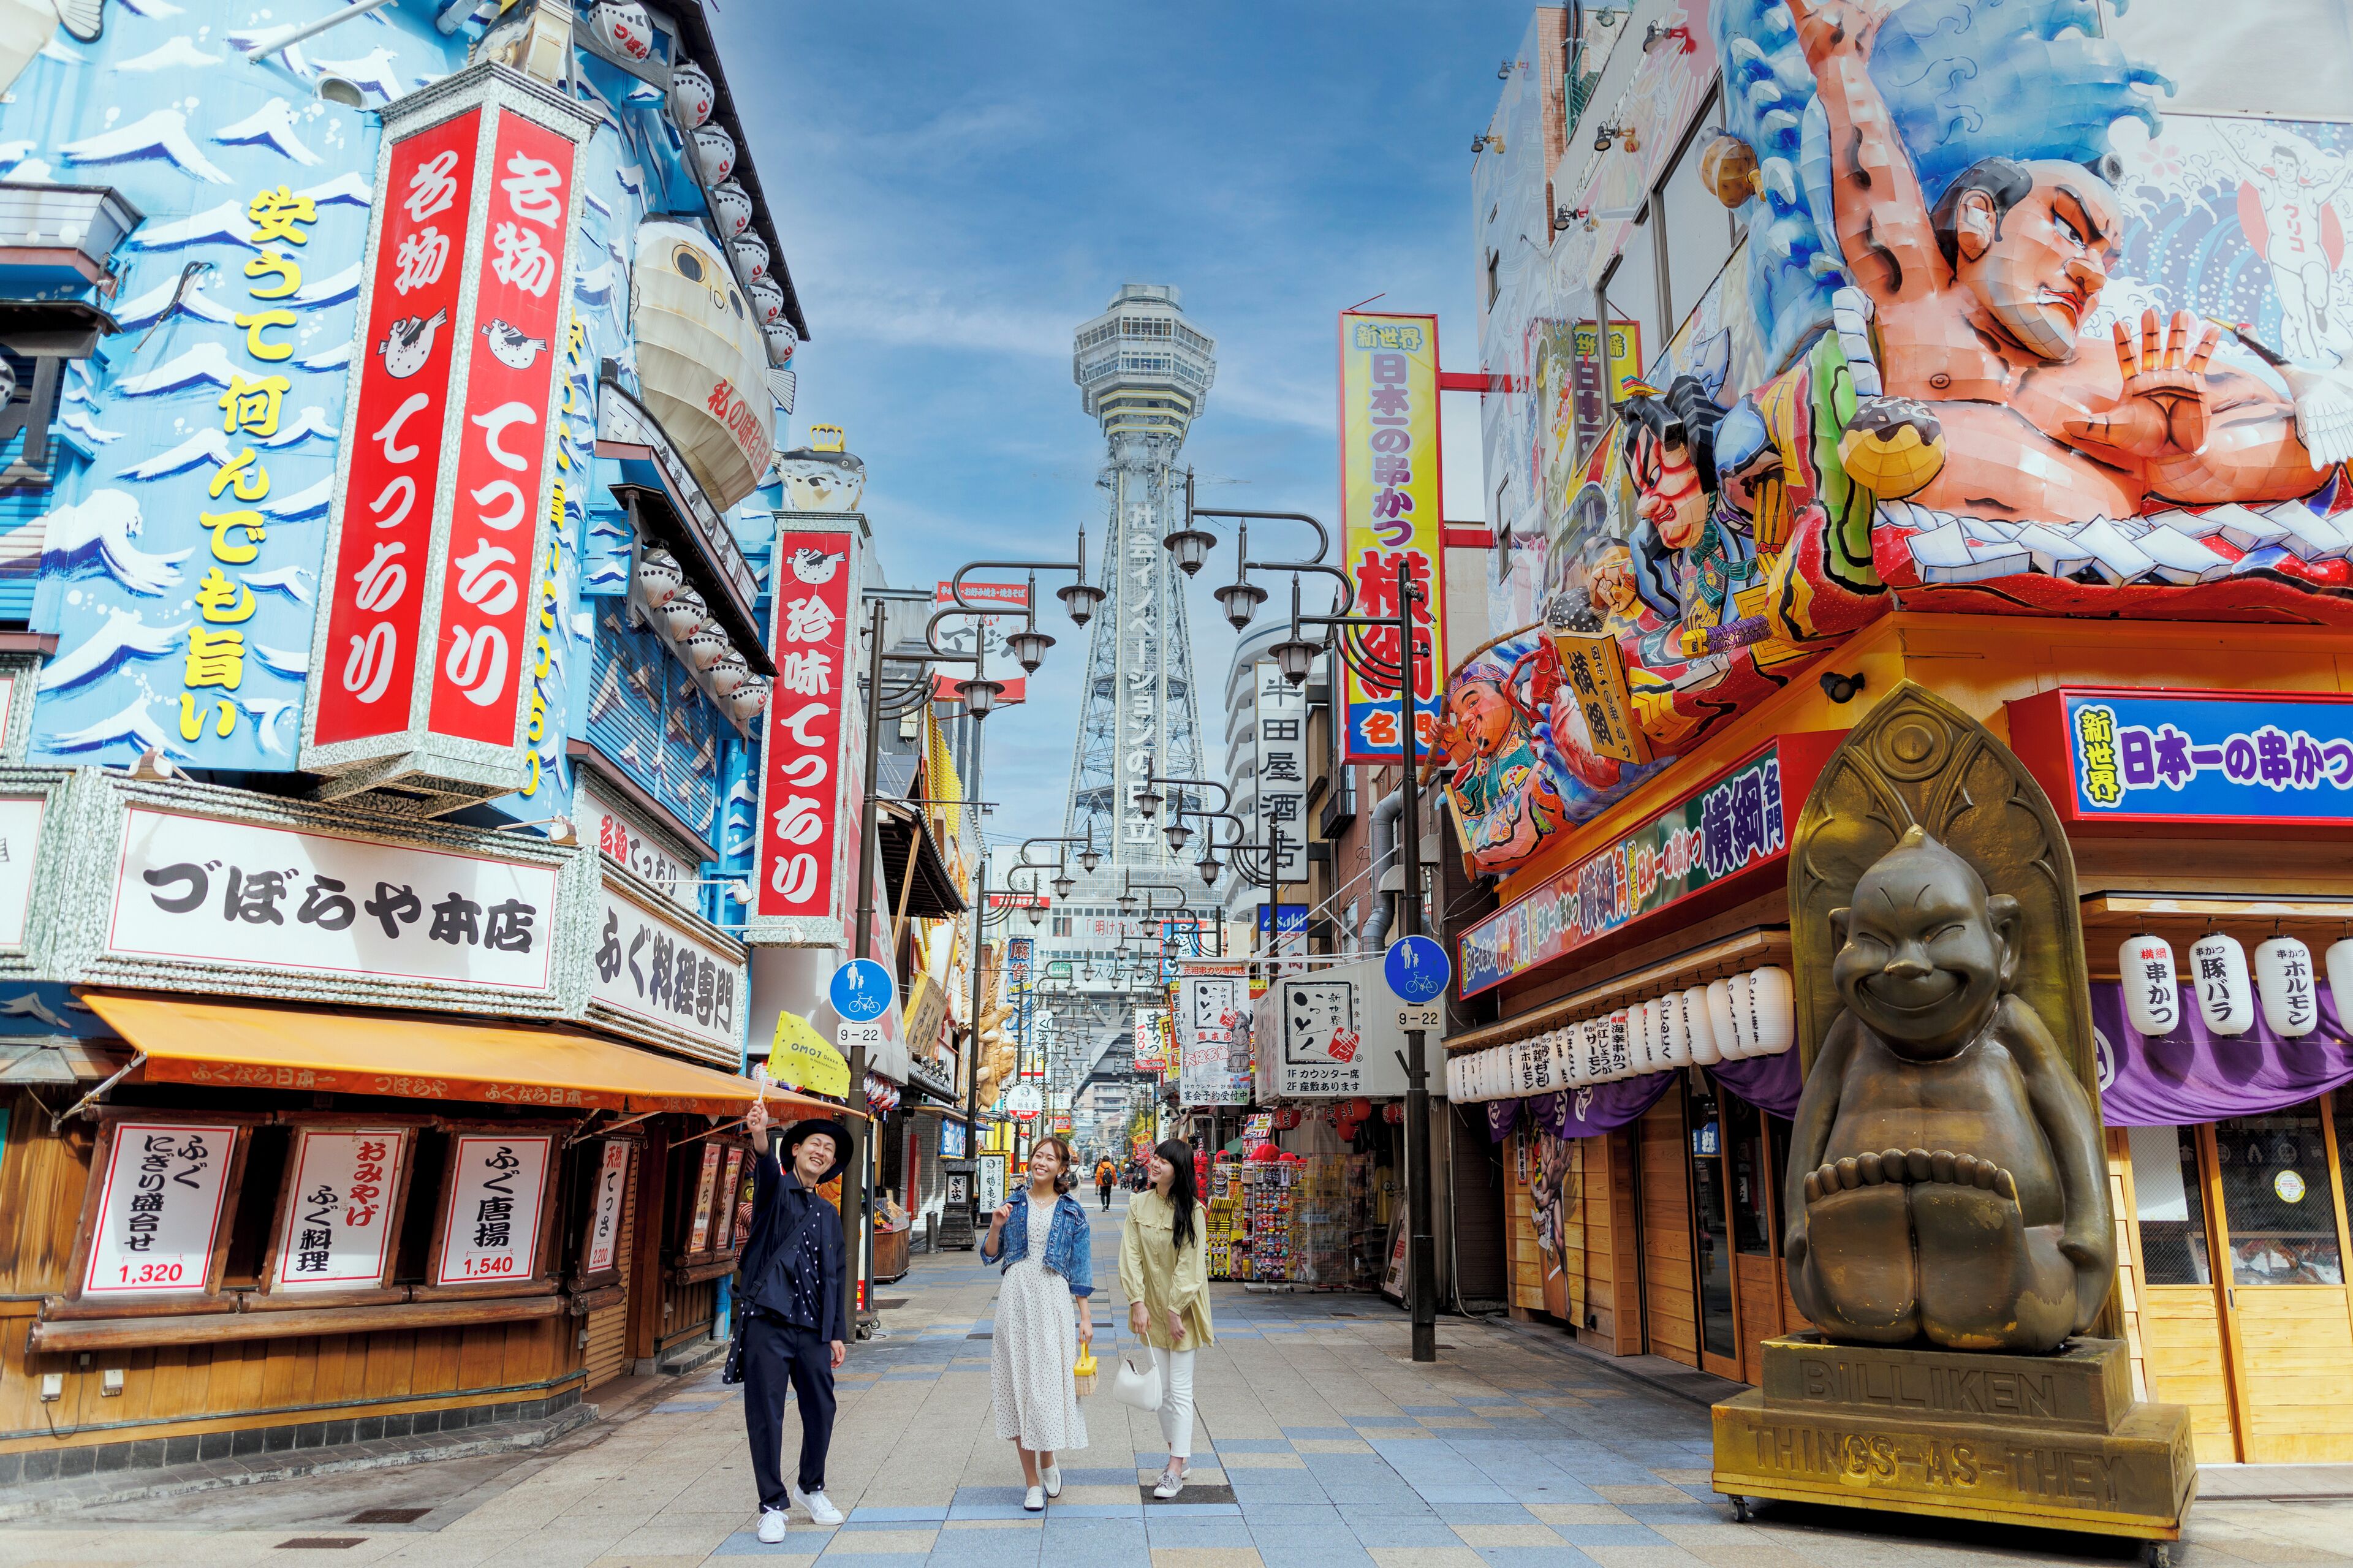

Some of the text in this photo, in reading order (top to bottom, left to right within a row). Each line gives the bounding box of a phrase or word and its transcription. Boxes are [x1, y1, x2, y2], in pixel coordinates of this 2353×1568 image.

[394, 150, 458, 297] 名物
[493, 151, 562, 298] 名物
[1357, 325, 1422, 351] 新世界
[179, 185, 317, 741] 安うて何んでも旨い
[1370, 354, 1413, 547] 日本一の串かつ
[1356, 550, 1434, 701] 横綱
[1124, 502, 1158, 844] 社会イノベーションの日立
[1570, 650, 1614, 747] 横綱
[1259, 675, 1304, 869] 半田屋酒店
[2081, 708, 2120, 803] 新世界
[2120, 729, 2353, 787] 日本一の串かつ
[1702, 768, 1764, 876] 横綱
[1765, 760, 1784, 848] 名門
[1628, 842, 1639, 913] 新世界
[1638, 830, 1702, 896] 日本一の串かつ
[143, 859, 536, 953] づぼらや本店
[594, 905, 734, 1034] ふぐ料理専門
[1009, 940, 1031, 982] 麻雀
[1183, 966, 1246, 975] 元祖串カツ専門店
[2140, 947, 2167, 960] 横綱
[2196, 945, 2226, 956] 串かつ
[2276, 949, 2306, 960] 串かつ
[1328, 993, 1343, 1027] 新世界
[2145, 961, 2173, 1025] 串かつ
[2201, 956, 2234, 1022] 豚バラ
[2284, 960, 2310, 1027] ホルモン
[191, 1062, 338, 1090] ふぐなら日本一
[791, 1043, 822, 1059] OMO7
[1183, 1045, 1230, 1068] 大阪名物
[1521, 1051, 1533, 1089] ホルモン
[1585, 1034, 1601, 1076] サーモン
[485, 1083, 599, 1105] ふぐなら日本一
[1183, 1090, 1248, 1101] 宴会予約受付中
[124, 1135, 175, 1252] にぎり盛合せ
[173, 1135, 208, 1189] ふぐ
[346, 1140, 388, 1227] おみやげ
[297, 1184, 339, 1273] ふぐ料理
[473, 1146, 520, 1248] ふぐ唐揚
[119, 1263, 183, 1284] 1,320
[464, 1256, 513, 1276] 1,540
[1800, 1358, 2056, 1418] BILLIKEN
